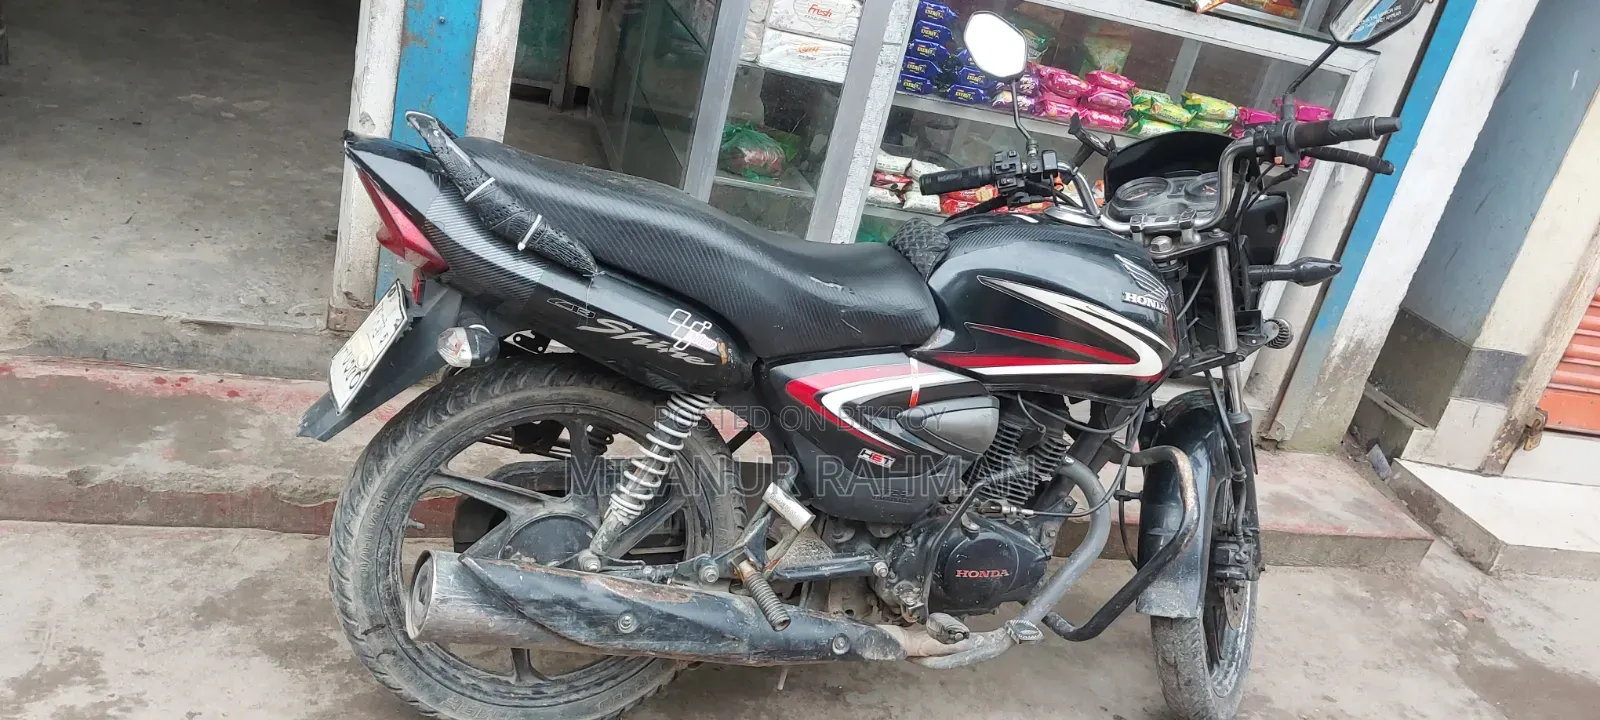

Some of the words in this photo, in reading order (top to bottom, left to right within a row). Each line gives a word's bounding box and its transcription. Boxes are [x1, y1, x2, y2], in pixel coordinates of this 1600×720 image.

[808, 4, 832, 18] Fresh
[1122, 292, 1169, 314] HONDA
[576, 318, 716, 366] Shine
[860, 449, 895, 466] HET
[955, 569, 1010, 579] HONDA
